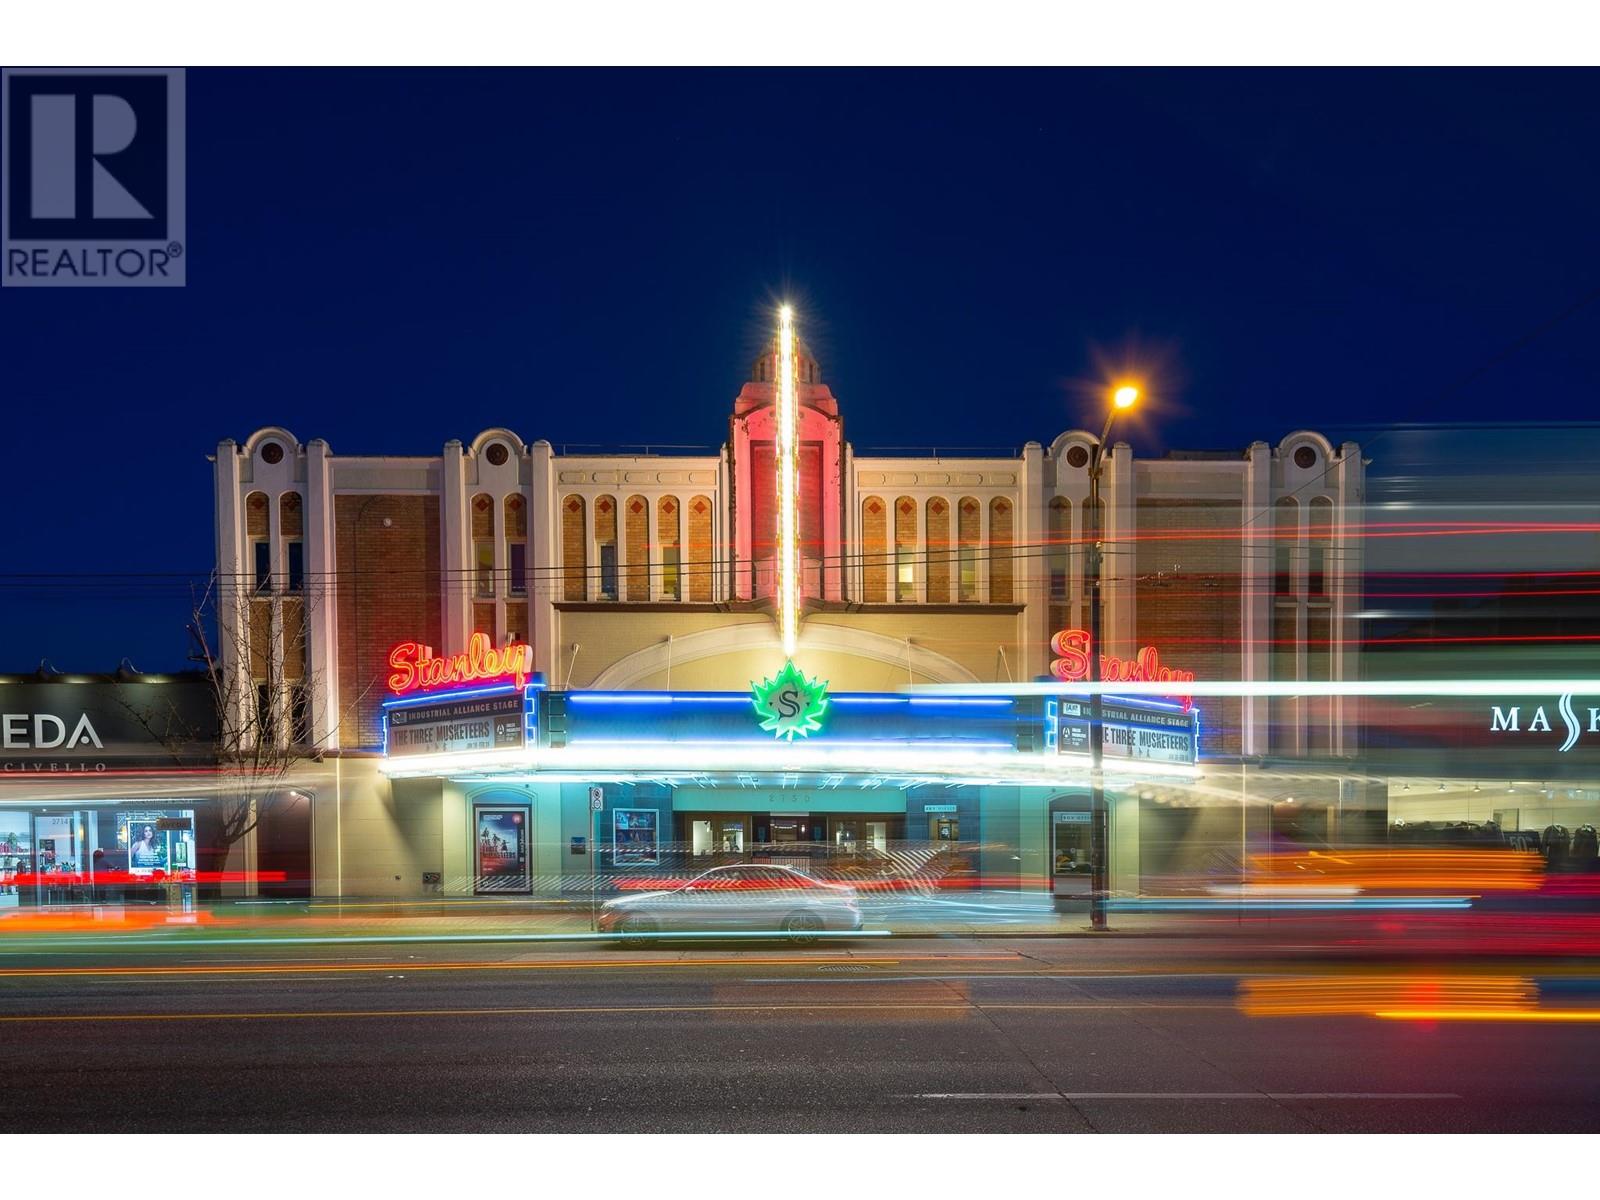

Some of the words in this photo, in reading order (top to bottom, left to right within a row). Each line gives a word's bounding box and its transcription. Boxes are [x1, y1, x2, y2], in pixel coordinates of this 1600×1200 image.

[388, 632, 532, 696] Stanley
[408, 707, 452, 720] INDUSTRIAL
[453, 702, 491, 716] ALLIANCE
[492, 699, 519, 711] STAGE
[777, 690, 800, 721] S
[3, 713, 105, 749] EDA
[1130, 711, 1165, 724] ALLIANCE
[1167, 718, 1189, 728] STAGE
[394, 730, 408, 746] THE
[409, 726, 434, 744] THREE
[436, 721, 490, 742] MUSKETEERS
[1111, 727, 1137, 746] THREE
[1139, 730, 1188, 751] MUSKETEERS
